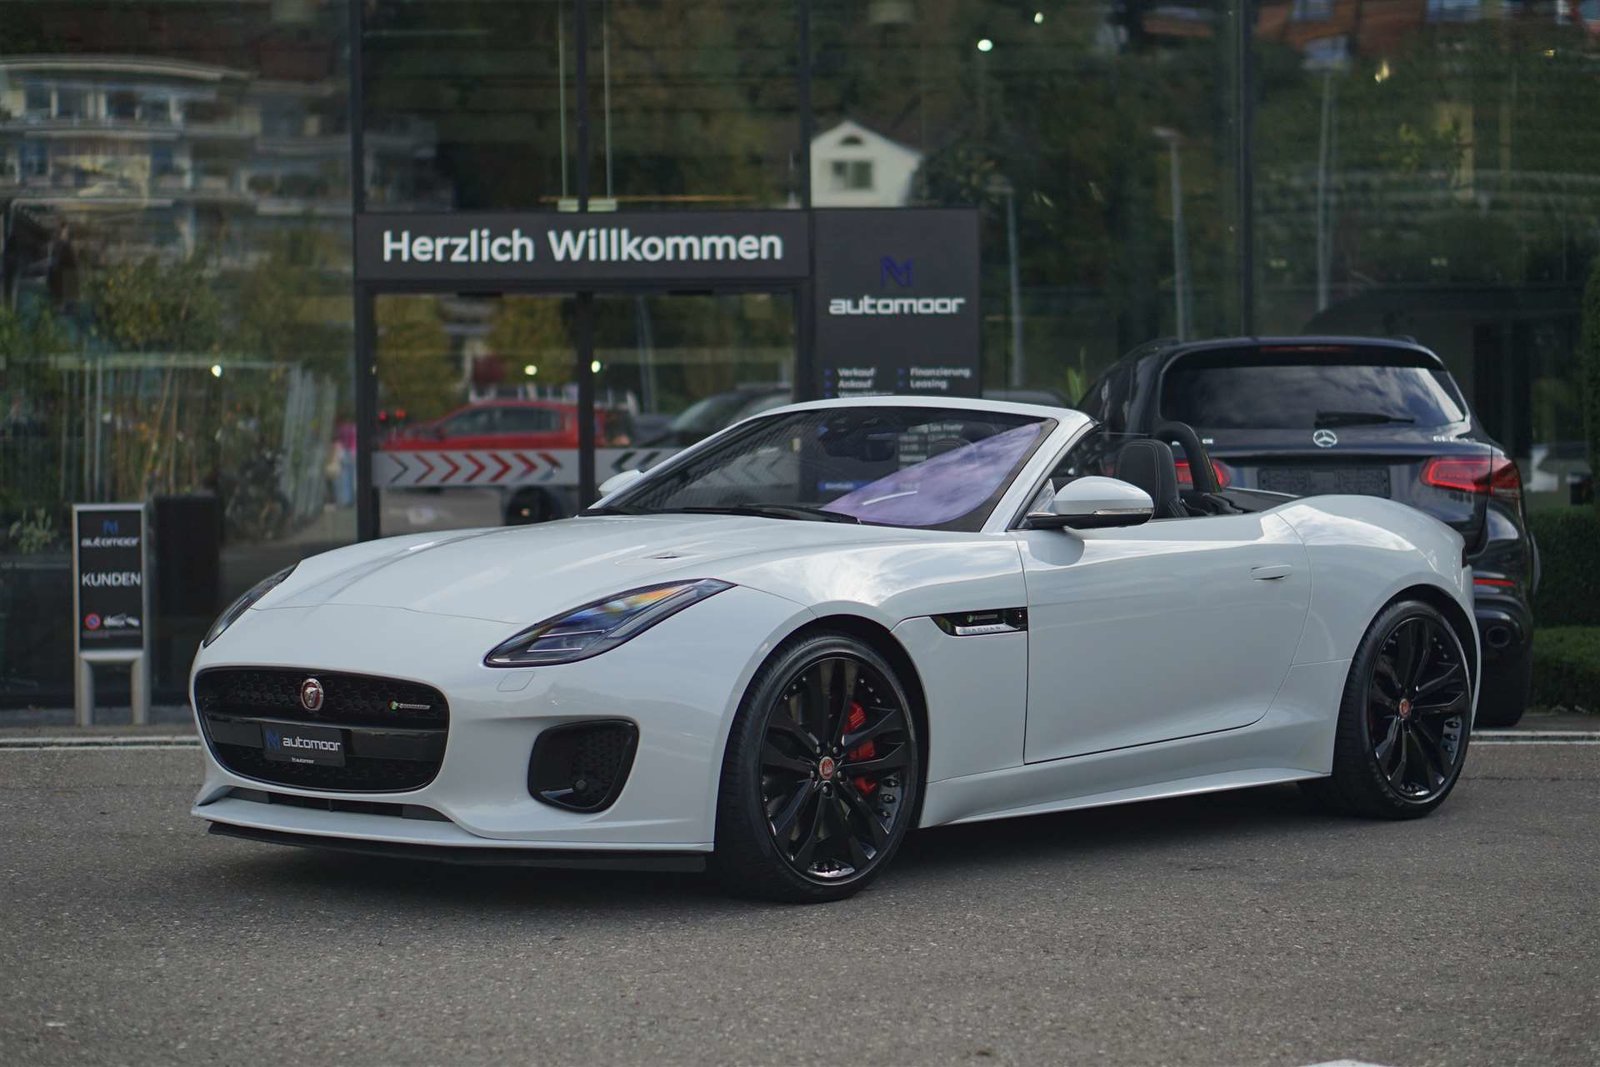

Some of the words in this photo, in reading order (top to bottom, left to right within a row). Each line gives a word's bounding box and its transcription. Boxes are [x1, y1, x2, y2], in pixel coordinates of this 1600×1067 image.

[383, 228, 535, 263] Herzlich
[547, 228, 783, 262] Willkommen
[828, 295, 966, 315] automoor
[838, 368, 876, 377] Verkauf
[910, 367, 971, 378] Finanzierung
[838, 379, 873, 388] Ankauf
[910, 379, 947, 389] Leasing
[81, 572, 141, 587] KUNDEN
[282, 736, 341, 752] automoor
